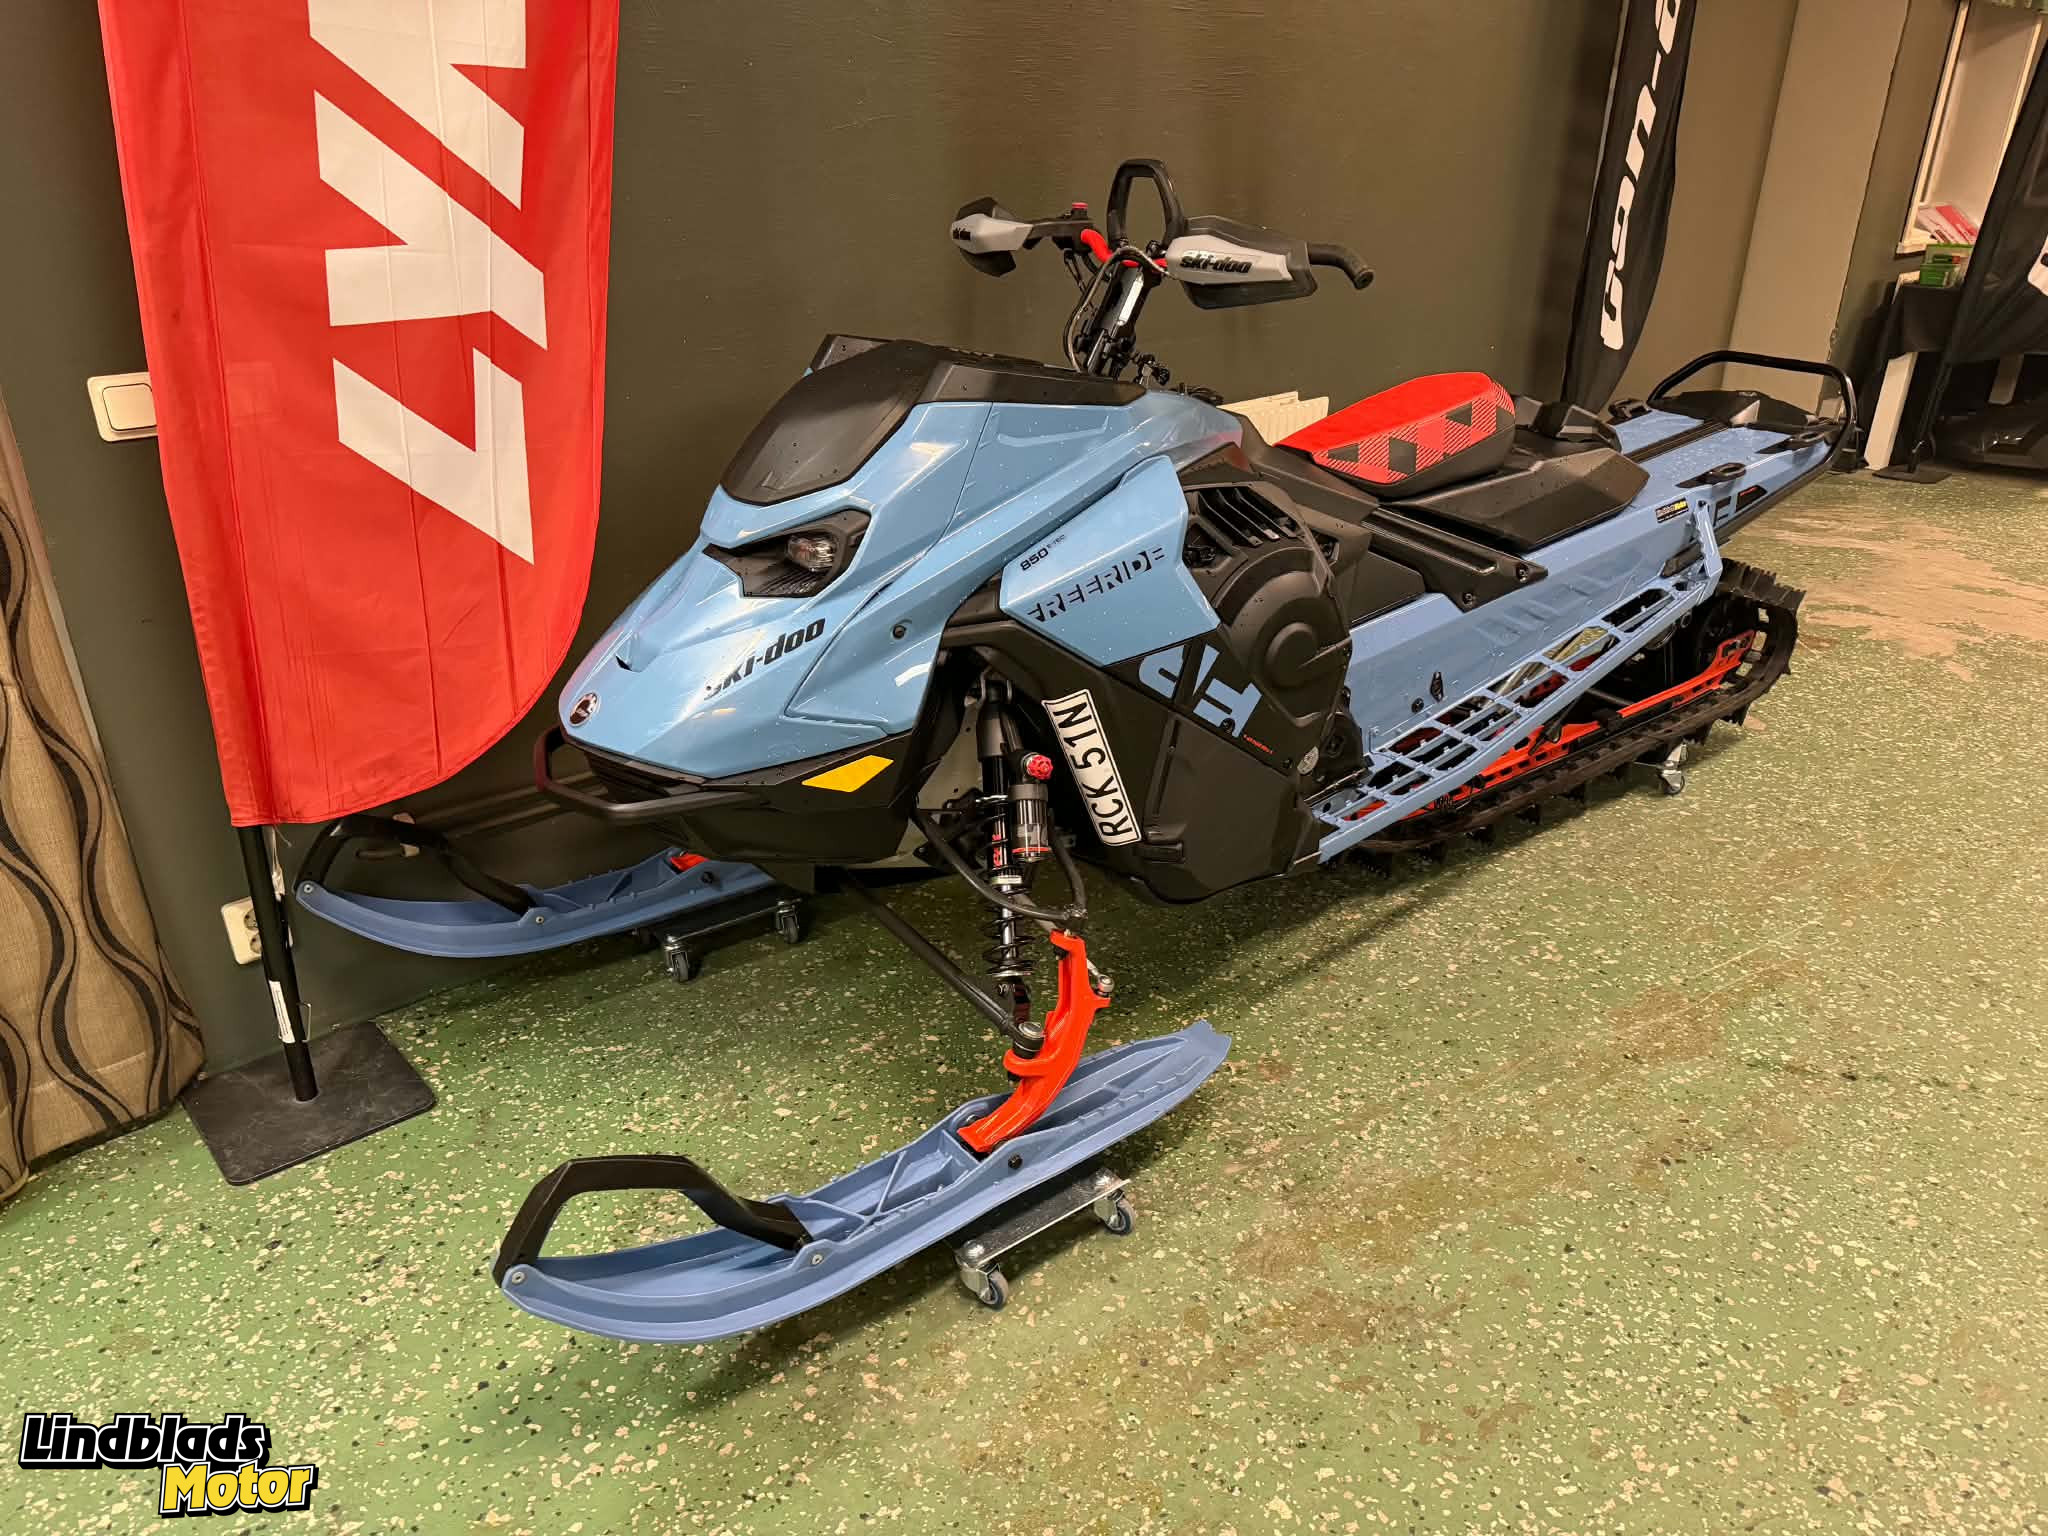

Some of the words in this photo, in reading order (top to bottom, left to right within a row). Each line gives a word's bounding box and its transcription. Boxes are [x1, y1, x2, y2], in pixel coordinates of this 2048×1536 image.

[1180, 253, 1253, 274] ski-doo
[1019, 546, 1049, 572] 850
[1027, 547, 1166, 622] FREERIDE
[1052, 701, 1106, 770] 51N
[1081, 775, 1133, 837] RCK
